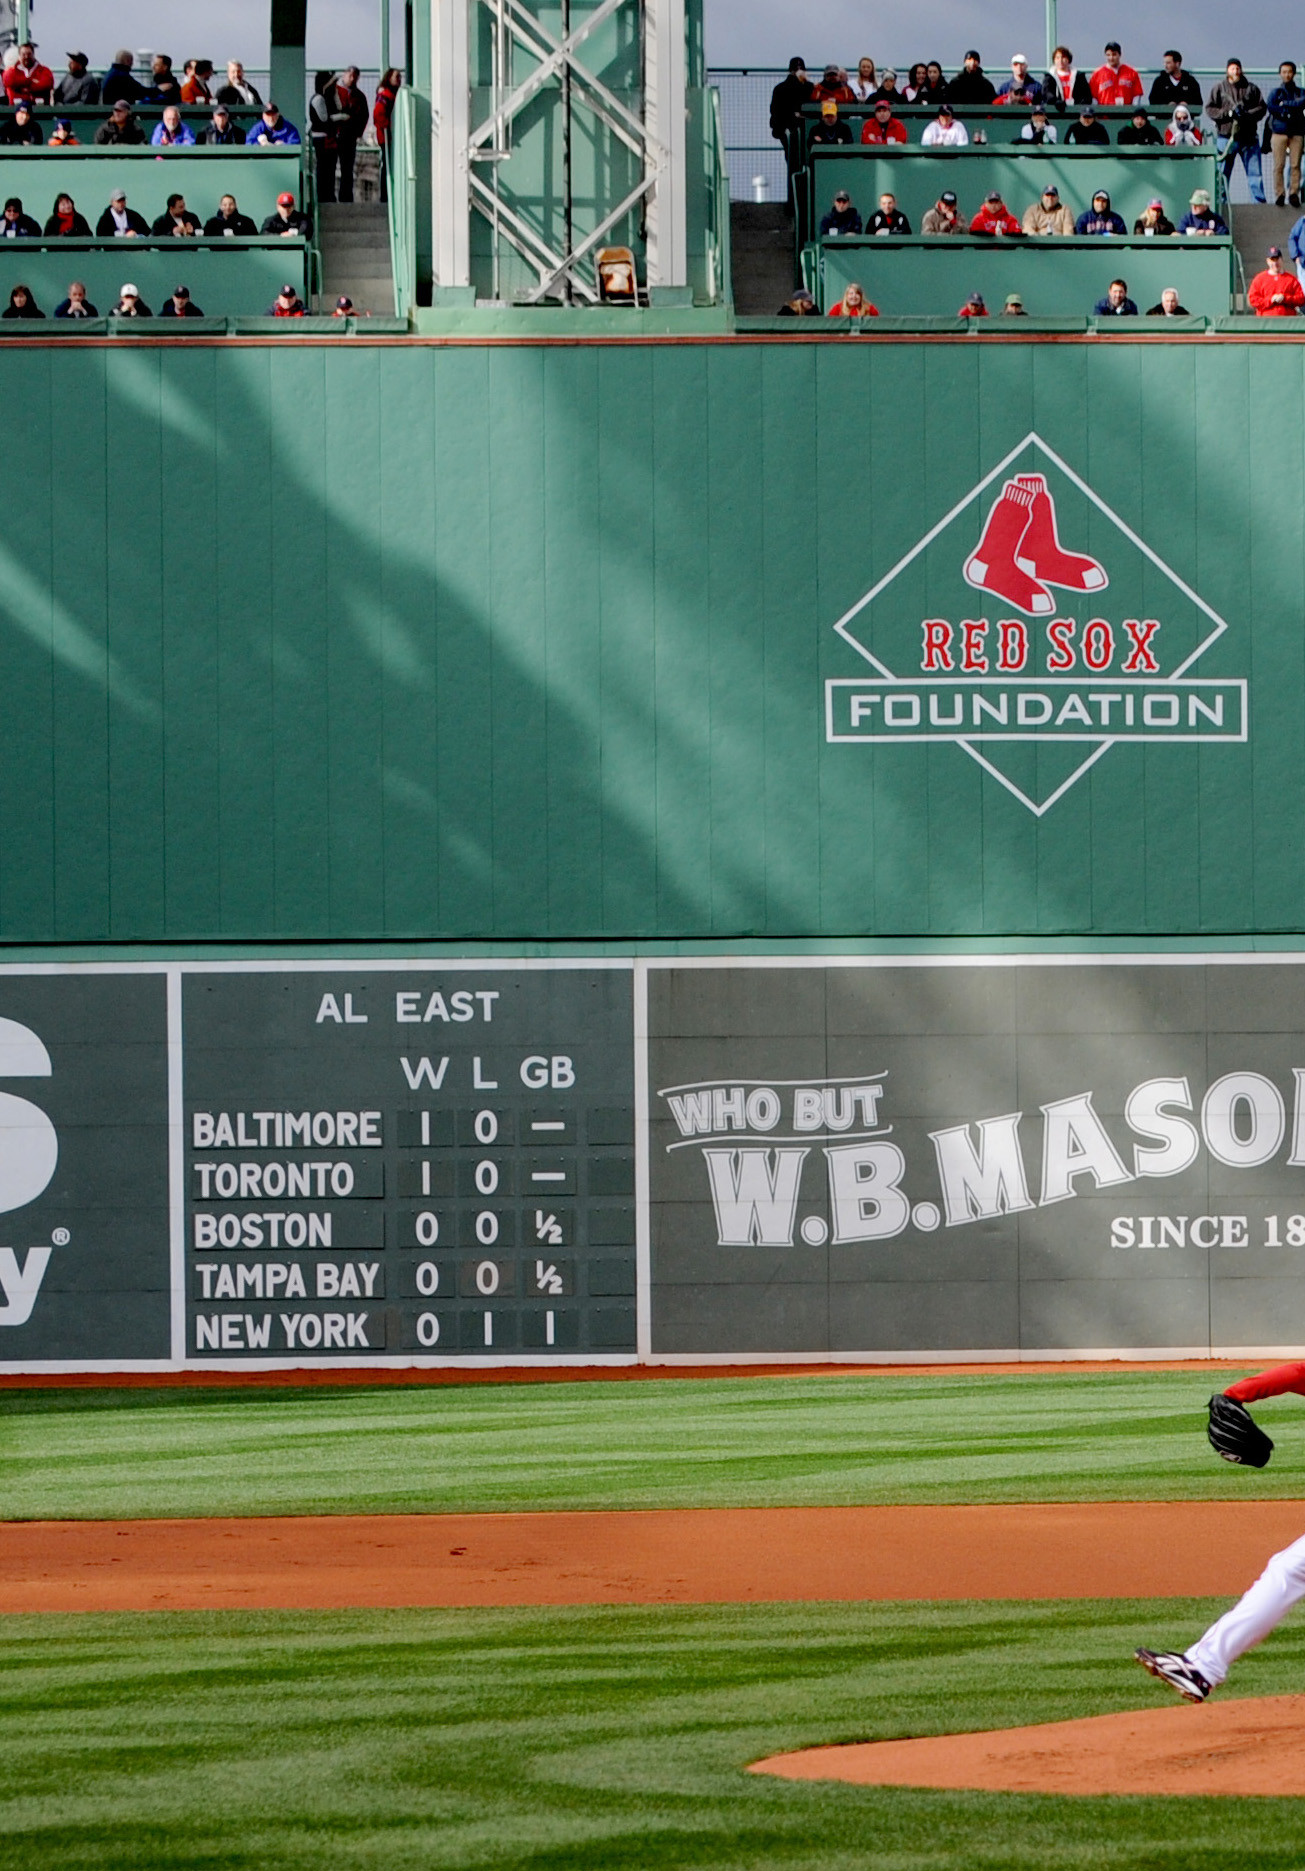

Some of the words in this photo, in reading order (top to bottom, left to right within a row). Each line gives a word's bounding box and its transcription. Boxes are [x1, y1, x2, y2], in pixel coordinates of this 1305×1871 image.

[920, 618, 1029, 673] RED
[1046, 618, 1161, 673] SOX
[851, 693, 1223, 726] FOUNDATION
[316, 993, 368, 1023] AL
[397, 991, 499, 1022] EAST
[400, 1057, 449, 1089] W
[474, 1057, 497, 1089] L
[520, 1056, 575, 1088] GB
[194, 1112, 381, 1147] BALTIMORE
[422, 1111, 429, 1145] 1
[475, 1110, 497, 1143] 0
[667, 1088, 781, 1137] WHO
[793, 1084, 884, 1131] BUT
[194, 1162, 354, 1197] TORONTO
[422, 1161, 430, 1195] 1
[476, 1160, 498, 1194] 0
[195, 1213, 332, 1248] BOSTON
[416, 1212, 438, 1245] 0
[476, 1211, 498, 1244] 0
[1111, 1216, 1248, 1248] SINCE
[196, 1264, 306, 1298] TAMPA
[317, 1263, 379, 1297] BAY
[416, 1262, 438, 1295] 0
[476, 1261, 499, 1294] 0
[197, 1314, 271, 1349] NEW
[280, 1313, 369, 1348] YORK
[417, 1312, 439, 1346] 0
[485, 1312, 492, 1345] 1
[547, 1311, 554, 1344] 1
